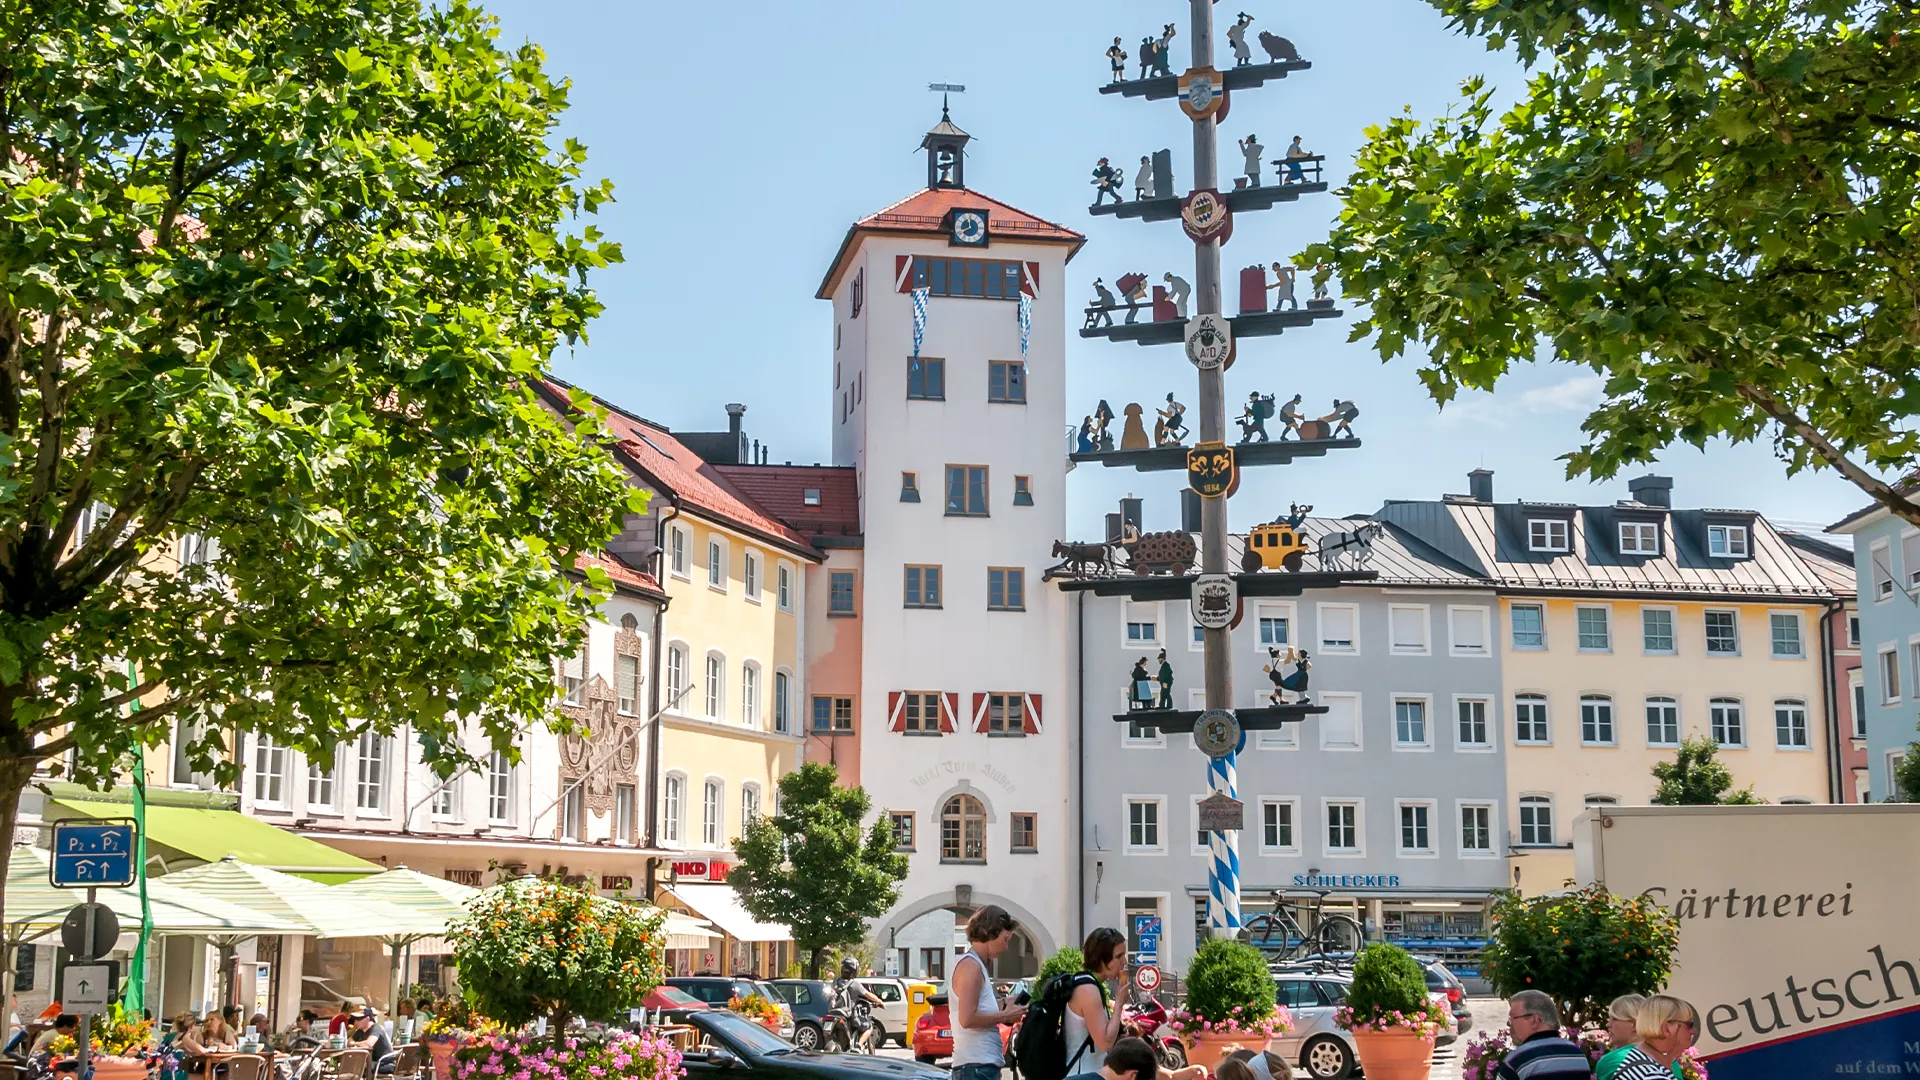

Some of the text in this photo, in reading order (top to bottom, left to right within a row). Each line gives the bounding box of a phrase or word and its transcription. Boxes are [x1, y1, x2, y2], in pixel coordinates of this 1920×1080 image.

[671, 862, 707, 875] NKD
[1293, 874, 1399, 887] SCHLECKER
[1687, 945, 1920, 1047] eutsch
[1835, 1060, 1862, 1073] auf
[1866, 1060, 1901, 1073] dem
